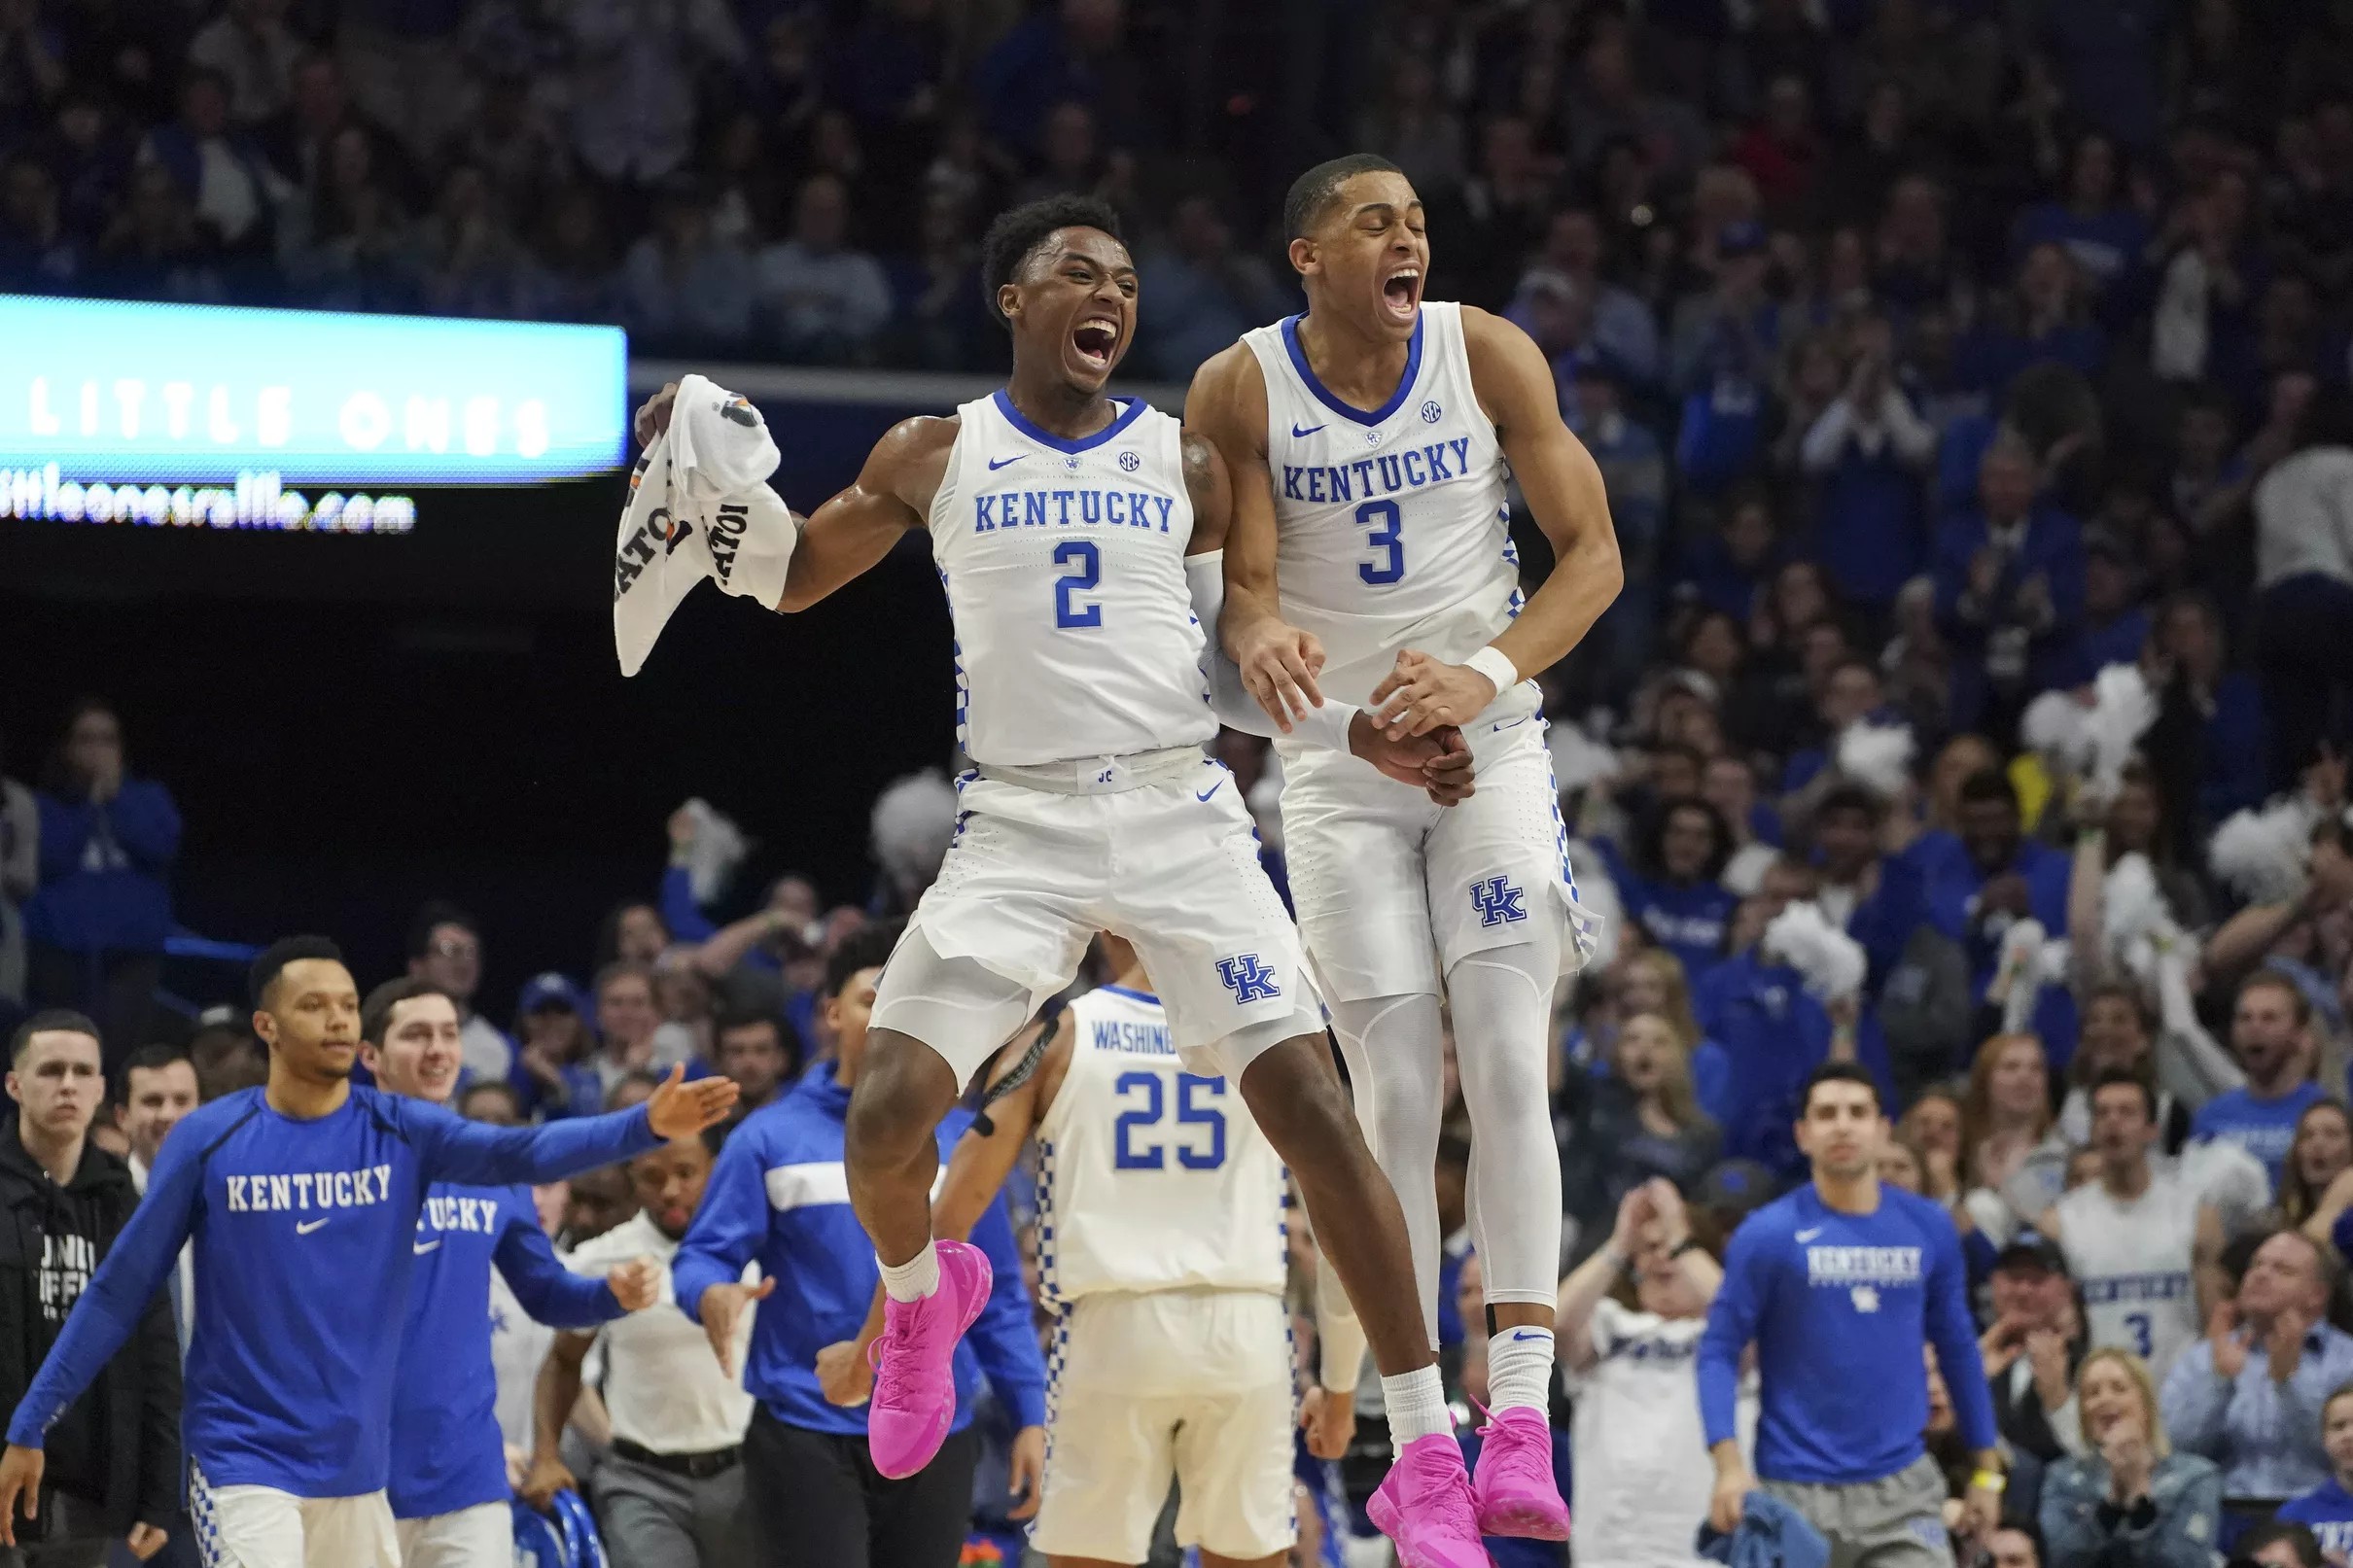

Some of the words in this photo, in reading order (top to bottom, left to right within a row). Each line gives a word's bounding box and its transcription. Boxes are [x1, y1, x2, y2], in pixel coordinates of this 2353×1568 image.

[30, 377, 291, 446] LITTLE
[340, 393, 548, 457] ONES
[1422, 401, 1442, 424] SEC
[1119, 451, 1140, 472] SEC
[1283, 437, 1470, 504] KENTUCKY
[975, 490, 1174, 534] KENTUCKY
[1354, 500, 1407, 584] 3
[1052, 540, 1103, 630] 2
[1470, 876, 1528, 927] UK
[1215, 953, 1281, 1005] UK
[1114, 1071, 1226, 1169] 25
[226, 1164, 392, 1212] KENTUCKY
